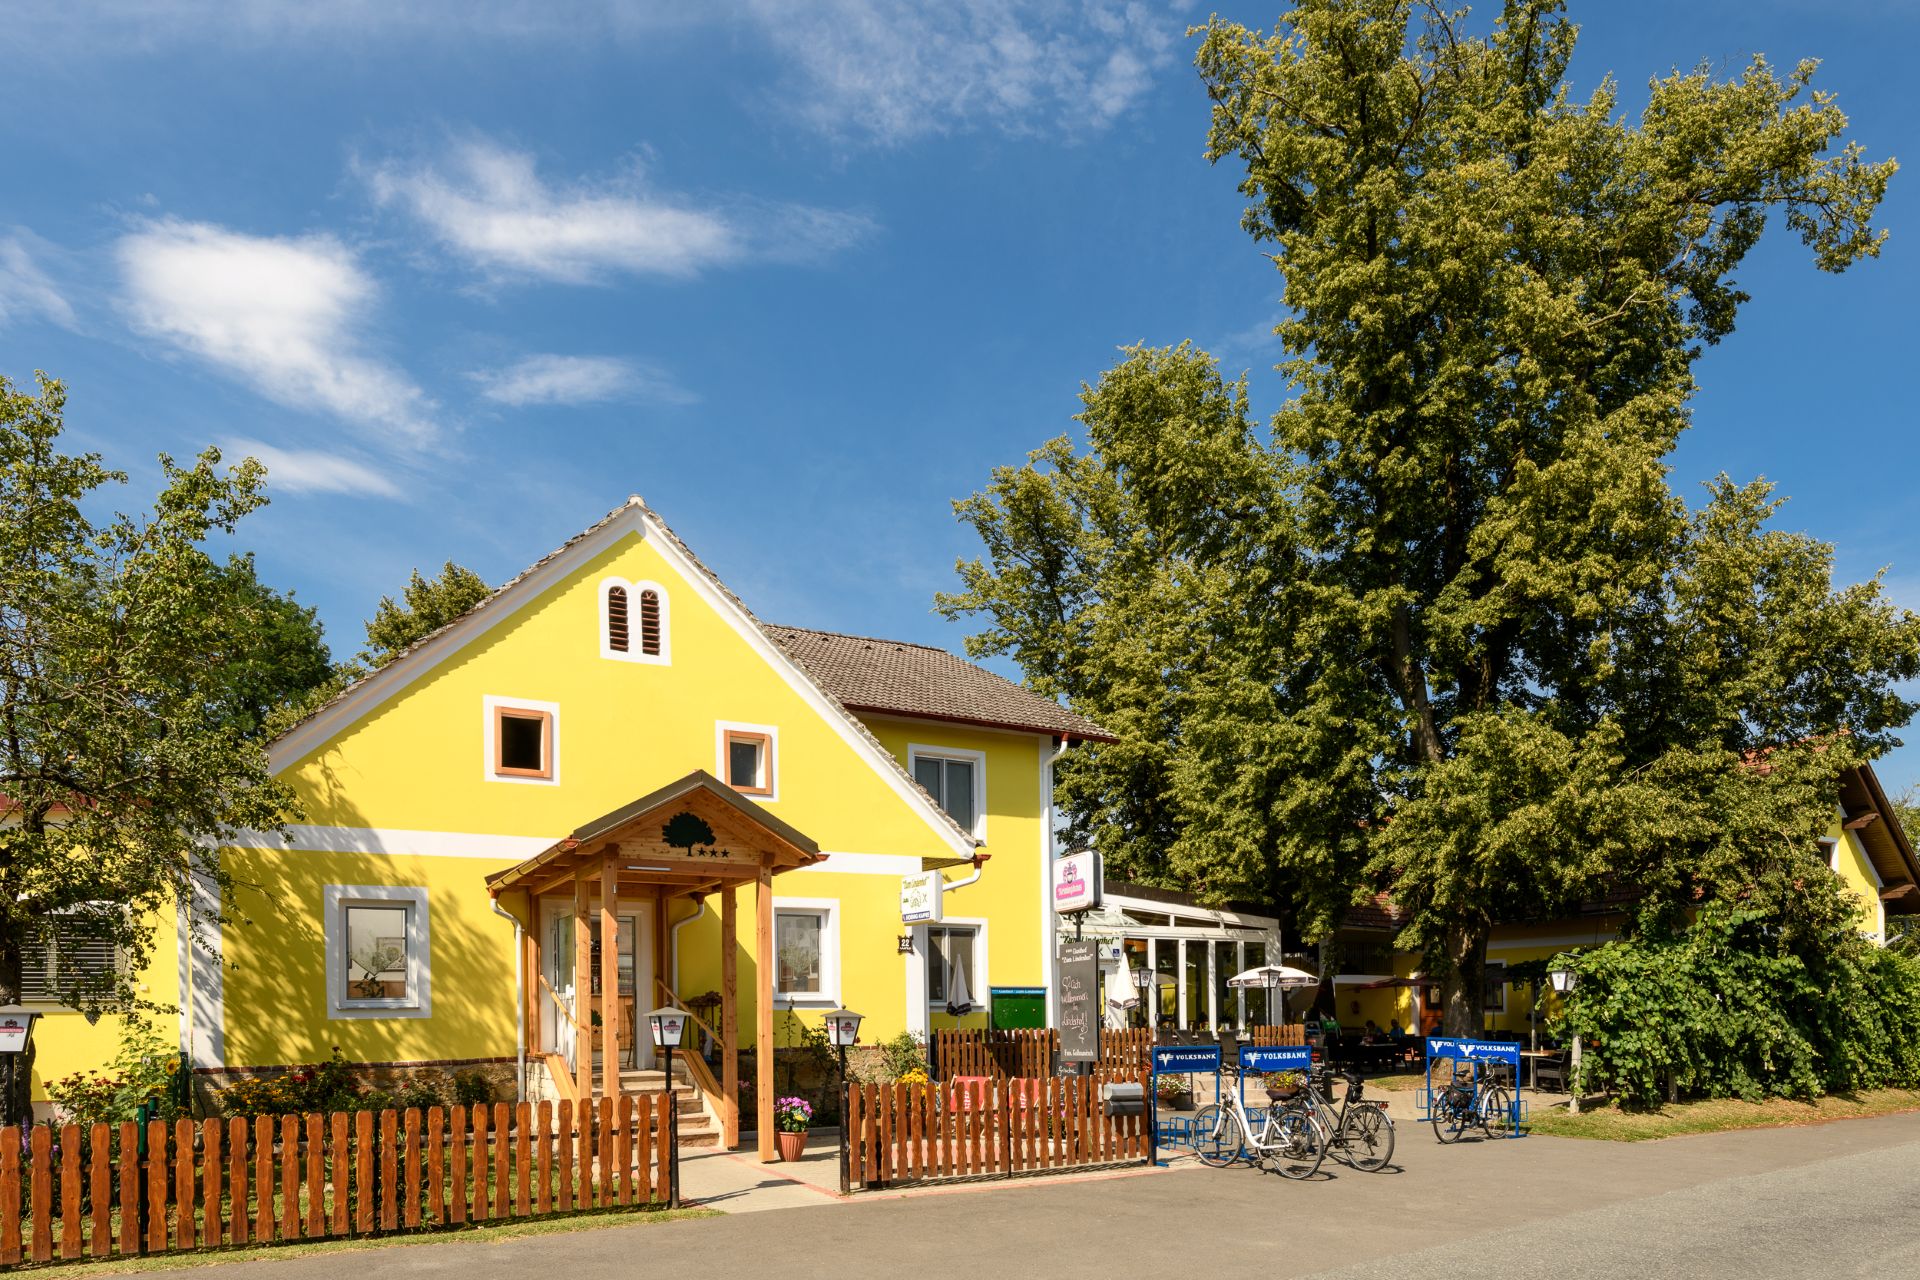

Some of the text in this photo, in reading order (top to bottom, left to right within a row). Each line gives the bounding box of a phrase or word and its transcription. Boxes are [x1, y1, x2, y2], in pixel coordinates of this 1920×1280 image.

[901, 938, 910, 947] 22
[1476, 1044, 1516, 1053] VOLKSBANK
[1176, 1053, 1217, 1061] VOLKSBANK
[1263, 1051, 1307, 1060] VOLKSBANK
